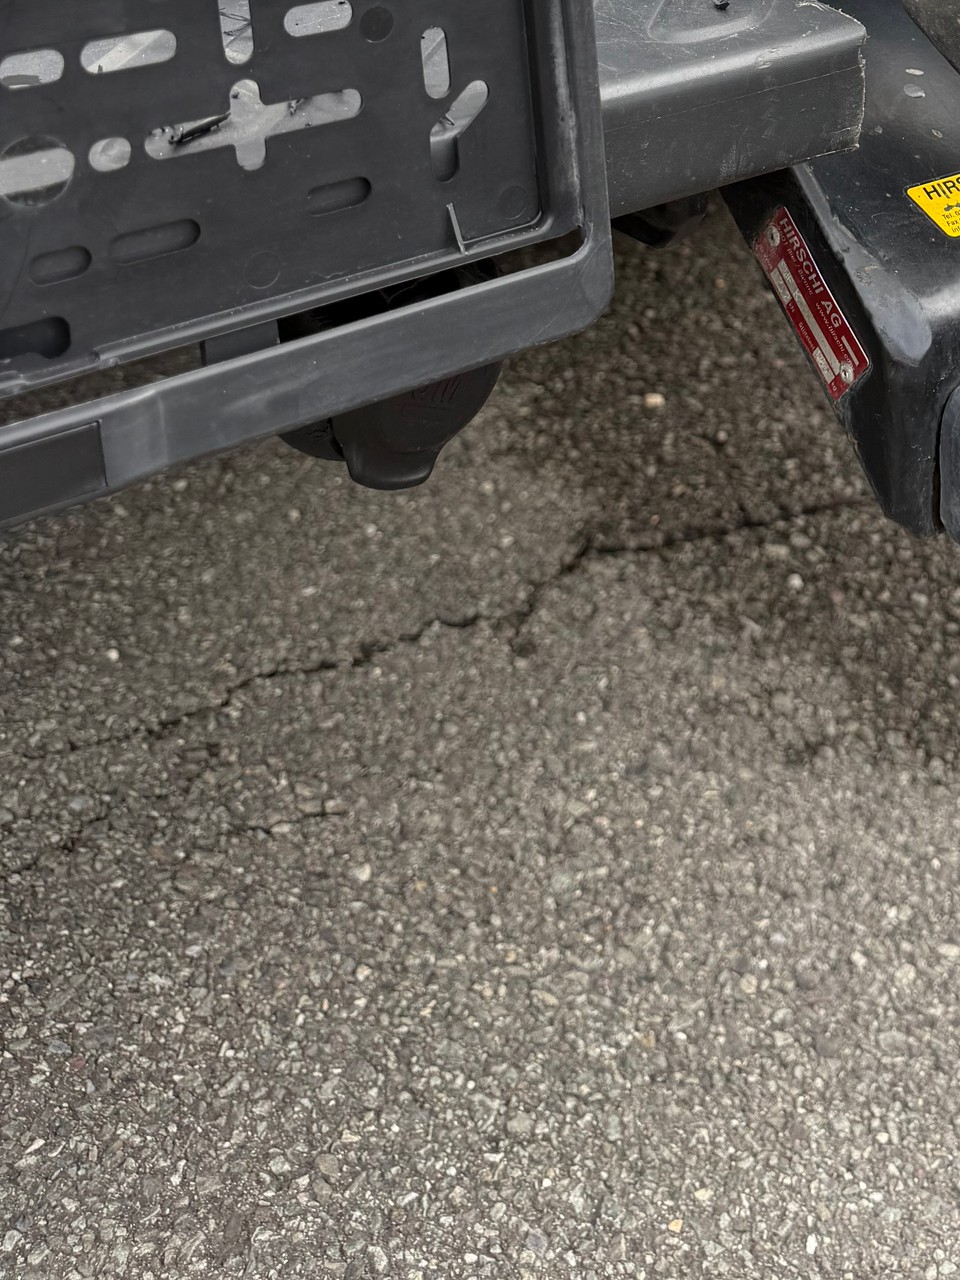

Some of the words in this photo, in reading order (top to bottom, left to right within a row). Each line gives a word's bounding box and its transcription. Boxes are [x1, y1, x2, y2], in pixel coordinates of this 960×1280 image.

[946, 218, 959, 228] Fax
[780, 218, 824, 294] HIRSCHI
[820, 300, 842, 328] AG
